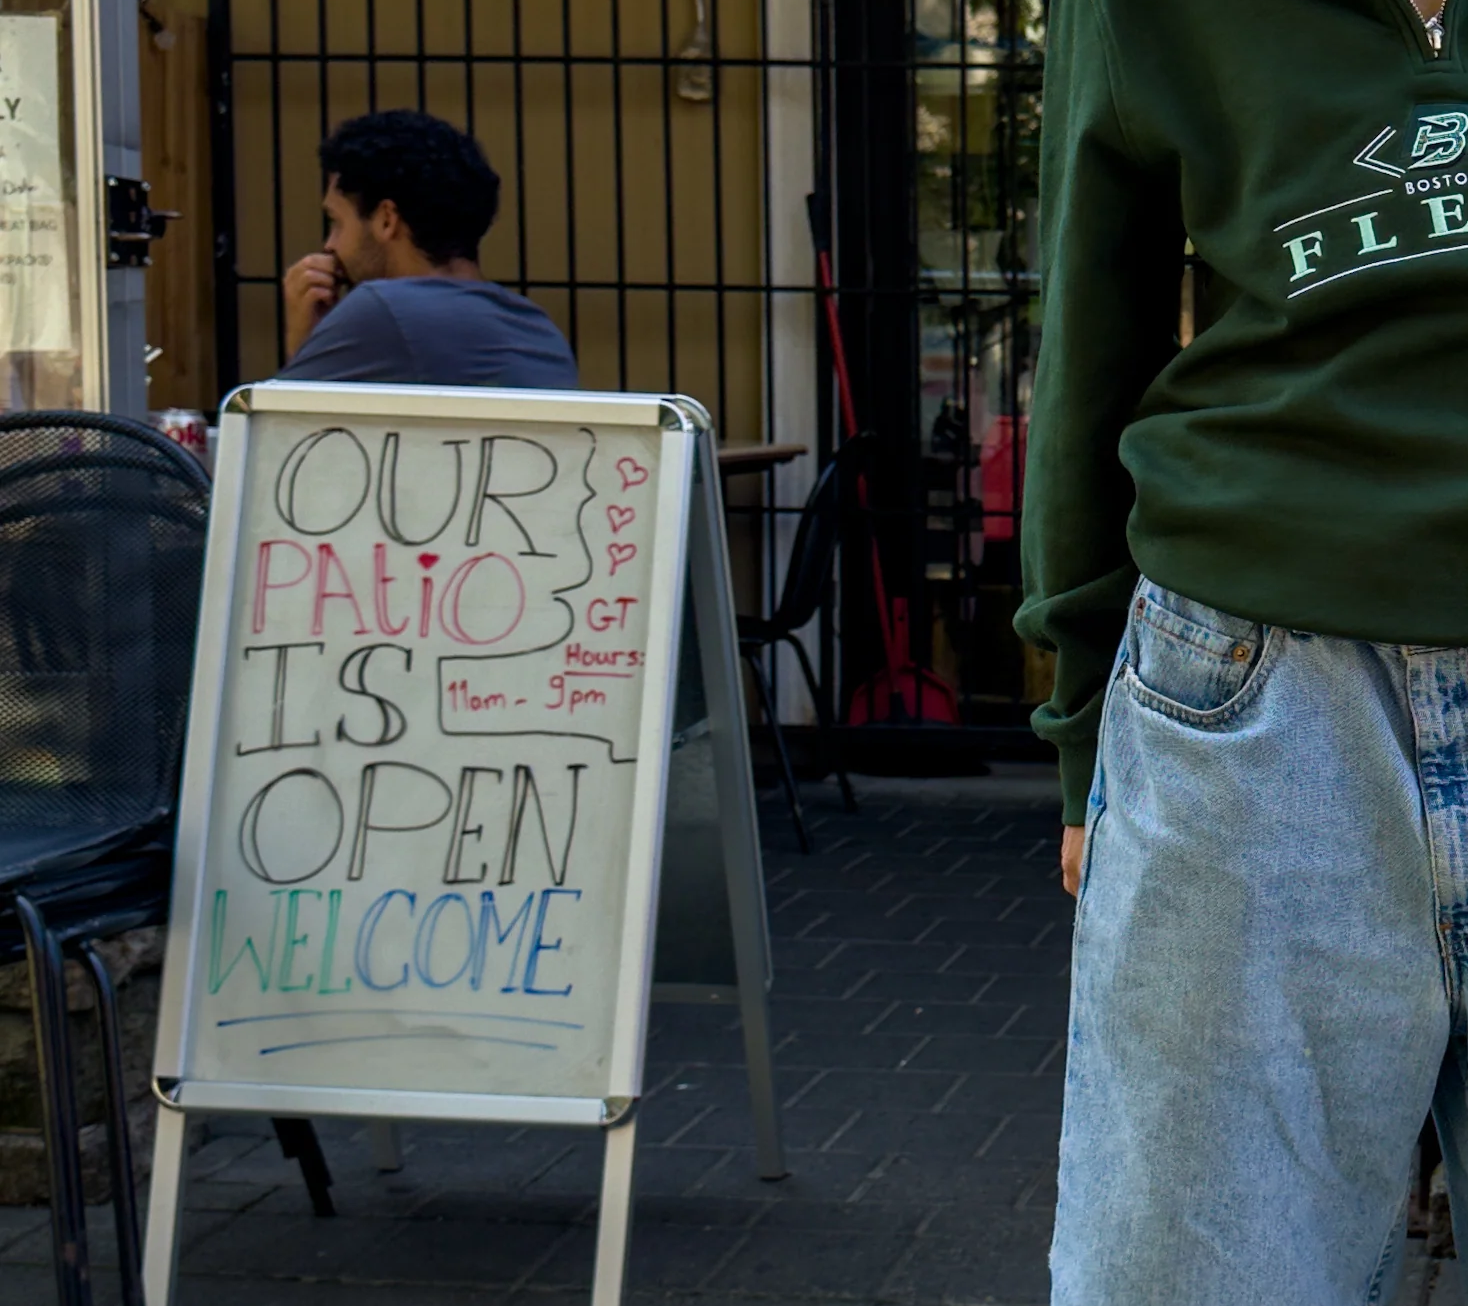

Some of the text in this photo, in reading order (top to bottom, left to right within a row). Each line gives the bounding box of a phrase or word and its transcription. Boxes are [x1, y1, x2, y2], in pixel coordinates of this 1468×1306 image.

[273, 425, 559, 559] OUR
[585, 597, 639, 633] GT
[236, 641, 413, 757] IS
[446, 679, 507, 713] 11am
[544, 674, 606, 715] 9pm
[238, 760, 588, 887] OPEN
[207, 886, 583, 997] WELCOME
